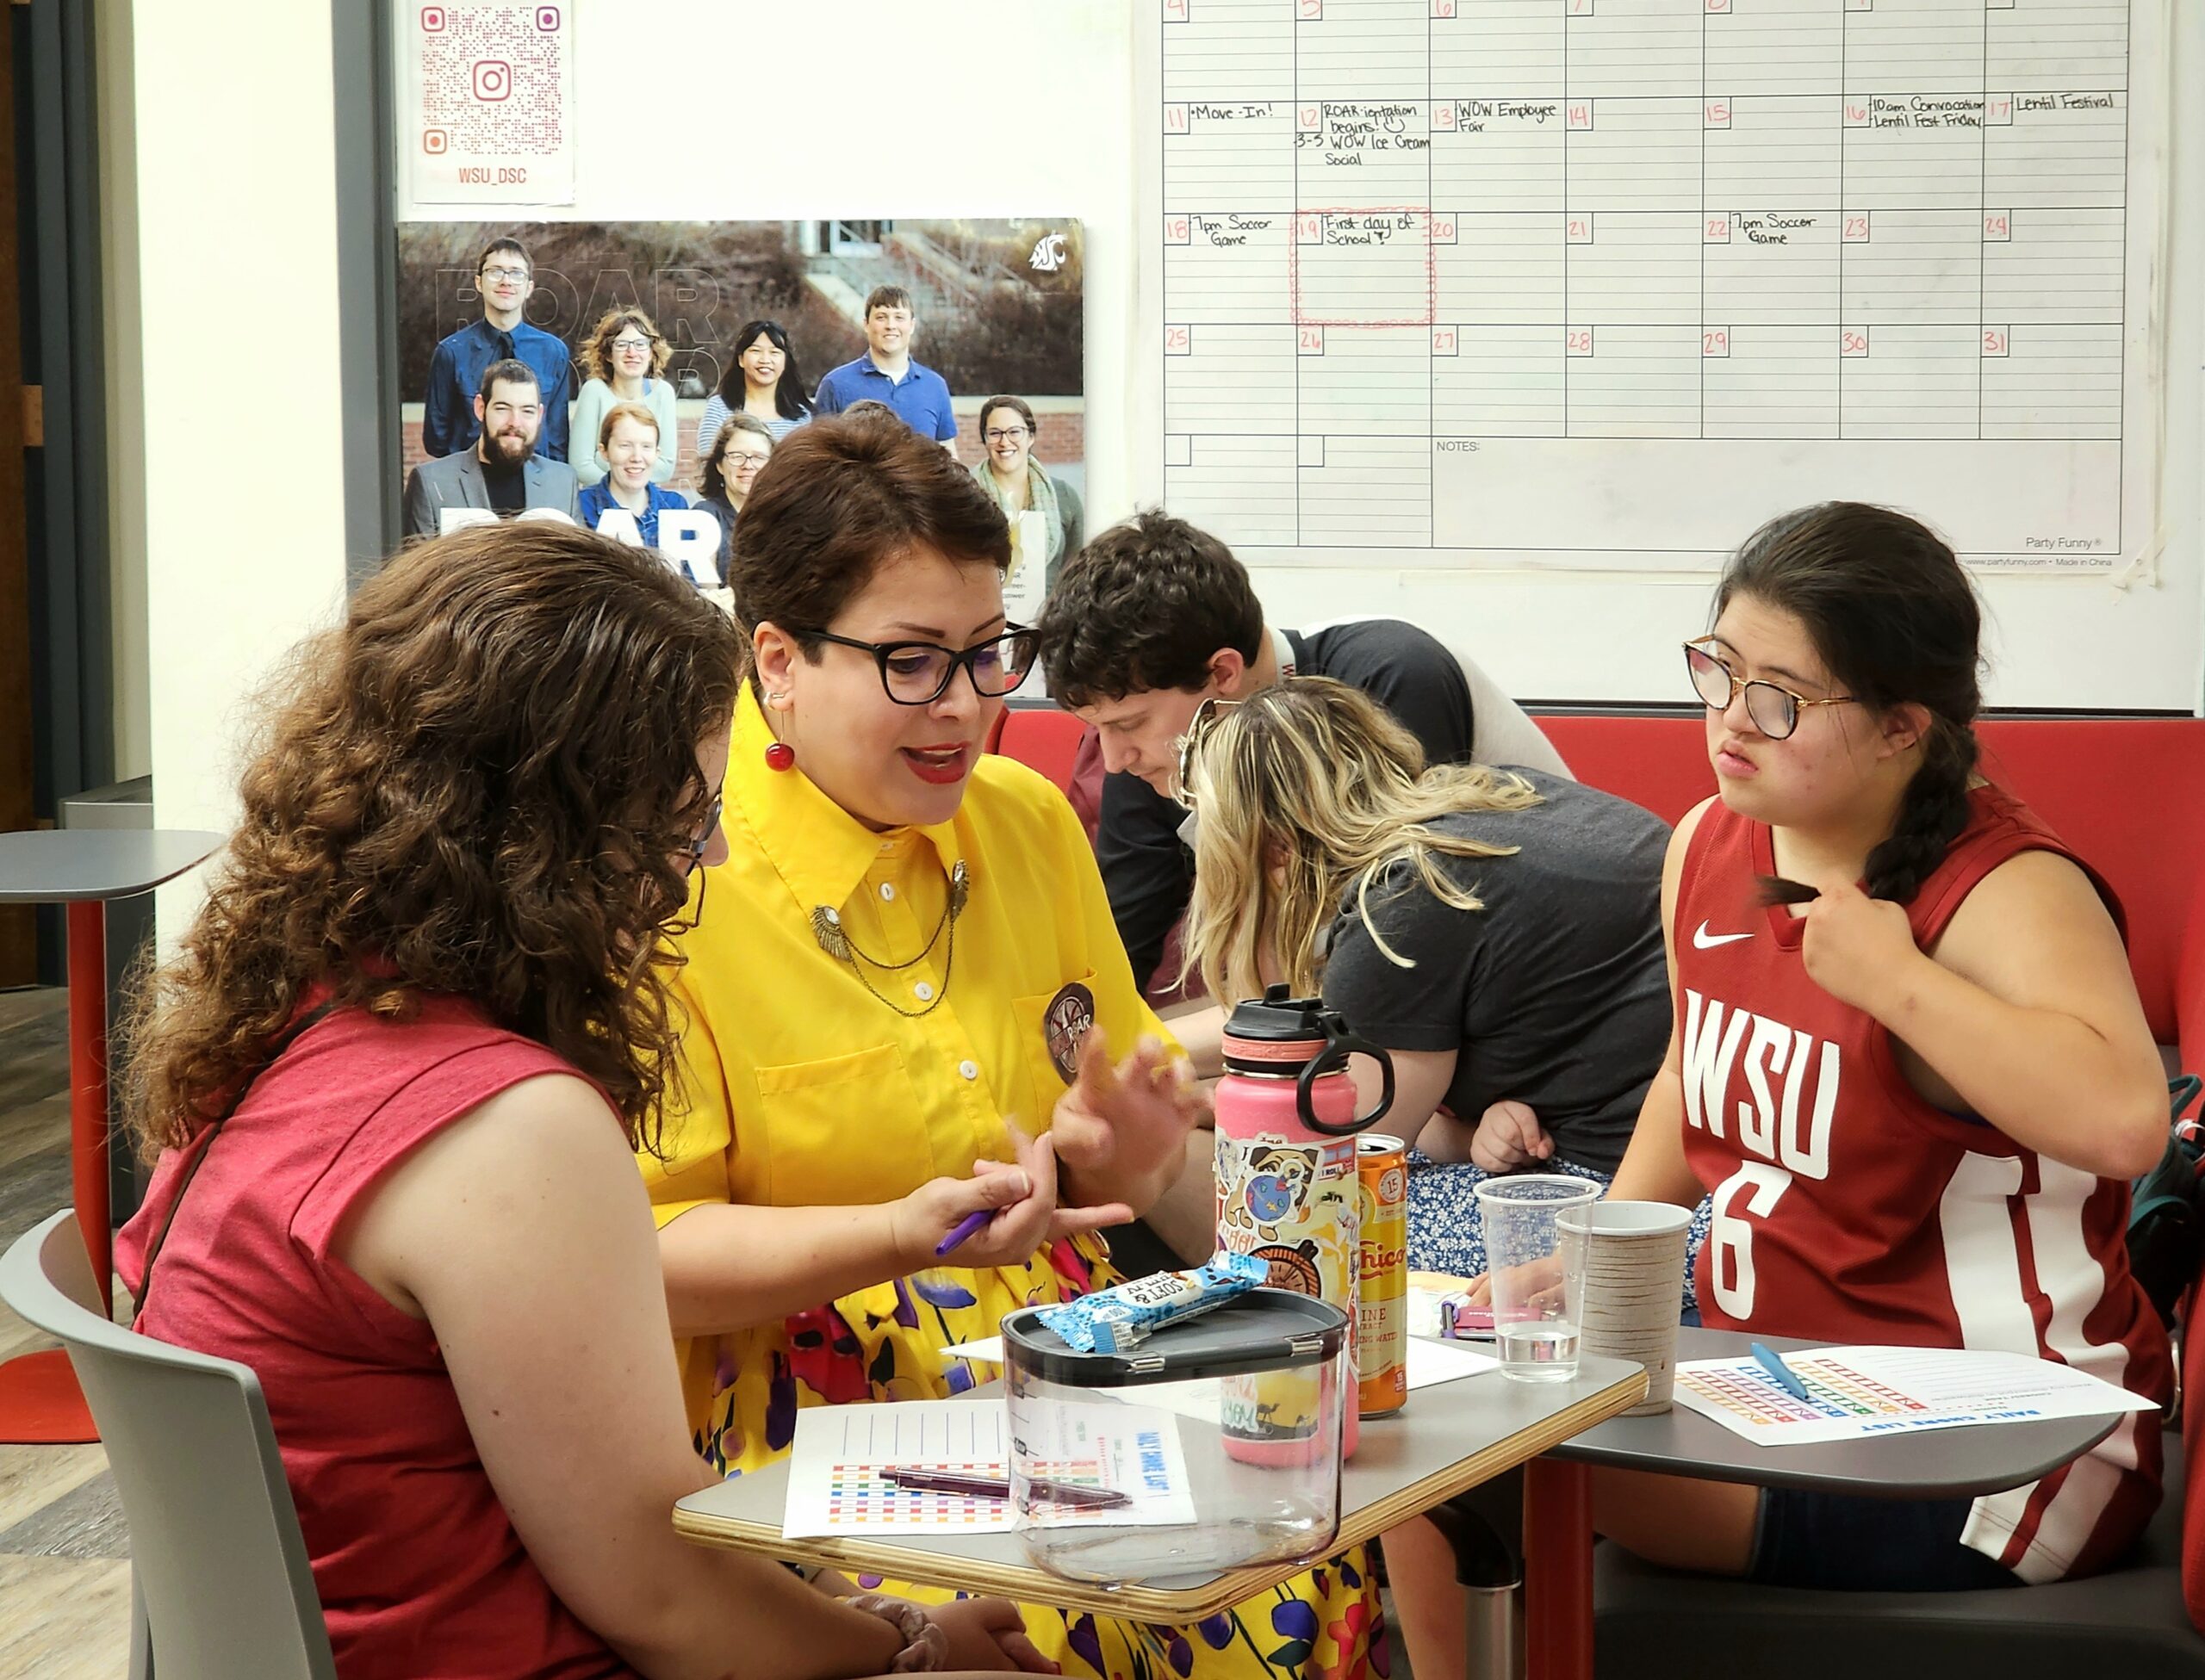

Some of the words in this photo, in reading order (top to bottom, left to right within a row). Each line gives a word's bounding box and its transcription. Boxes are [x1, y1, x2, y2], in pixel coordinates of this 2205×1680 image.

[1990, 101, 2011, 117] 17
[2016, 93, 2056, 111] Lentil
[2060, 93, 2114, 109] Festival
[1169, 108, 1184, 128] 11
[1301, 108, 1319, 127] 12
[1434, 108, 1454, 125] 13
[1458, 102, 1493, 117] WOW
[1498, 102, 1556, 123] Employee
[1568, 106, 1588, 126] 14
[1705, 104, 1730, 123] 15
[1846, 103, 1866, 121] 16
[1873, 113, 1910, 127] Lentil
[1914, 113, 1941, 127] Fest
[1941, 113, 1982, 129] Friday
[1458, 118, 1485, 133] Fair
[1330, 134, 1366, 150] WOW
[1371, 133, 1389, 150] Ice
[1394, 134, 1431, 150] Cream
[1325, 152, 1363, 166] Social
[458, 167, 528, 185] WSU_DSC
[1166, 220, 1188, 239] 18
[1192, 215, 1223, 234] 7pm
[1299, 220, 1317, 238] 19
[1323, 214, 1360, 230] First
[1363, 216, 1392, 239] day
[1397, 213, 1415, 230] of
[1432, 221, 1454, 239] 20
[1568, 220, 1587, 237] 21
[1707, 220, 1730, 237] 22
[1731, 213, 1763, 233] 7pm
[1766, 213, 1817, 229] Soccer
[1845, 217, 1868, 238] 23
[1984, 217, 2007, 237] 24
[1210, 231, 1247, 248] Game
[1748, 230, 1788, 245] Game
[1166, 328, 1189, 348] 25
[1300, 329, 1322, 350] 26
[1433, 332, 1455, 350] 27
[1567, 332, 1591, 351] 28
[1703, 332, 1727, 355] 29
[1842, 331, 1867, 353] 30
[1983, 331, 2007, 353] 31
[1437, 441, 1481, 453] NOTES:
[2026, 537, 2055, 549] Party
[2089, 558, 2113, 567] China
[1681, 988, 1841, 1181] WSU
[1711, 1159, 1793, 1321] 6
[1134, 1293, 1152, 1305] &
[1147, 1280, 1184, 1301] SOFT
[1361, 1307, 1387, 1322] INE
[1984, 1409, 2041, 1420] DAILY
[1860, 1422, 1906, 1432] LIST
